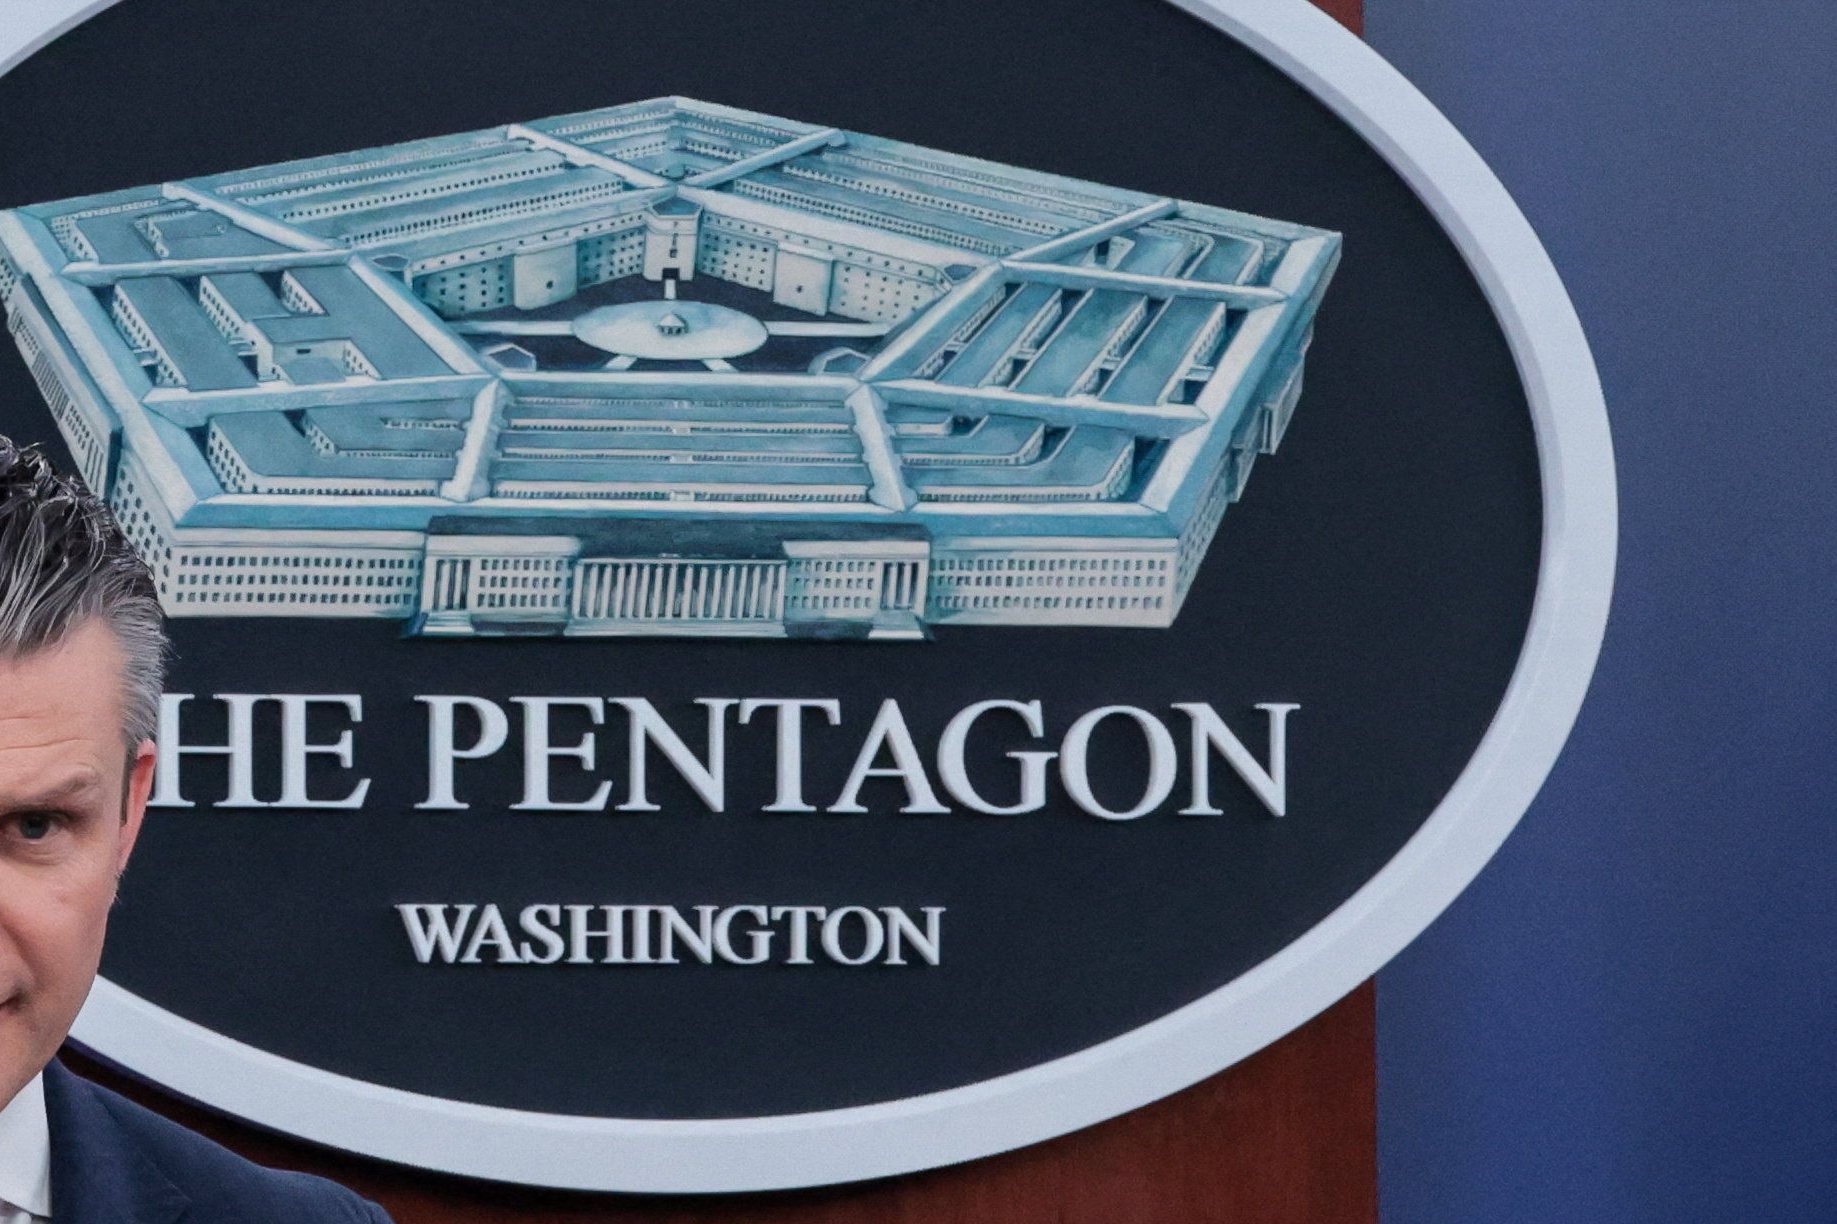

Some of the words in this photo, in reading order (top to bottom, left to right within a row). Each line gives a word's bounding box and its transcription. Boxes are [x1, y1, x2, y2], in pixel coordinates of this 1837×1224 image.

[145, 693, 372, 810] HE
[413, 694, 1301, 820] PENTAGON
[393, 903, 947, 965] WASHINGTON
